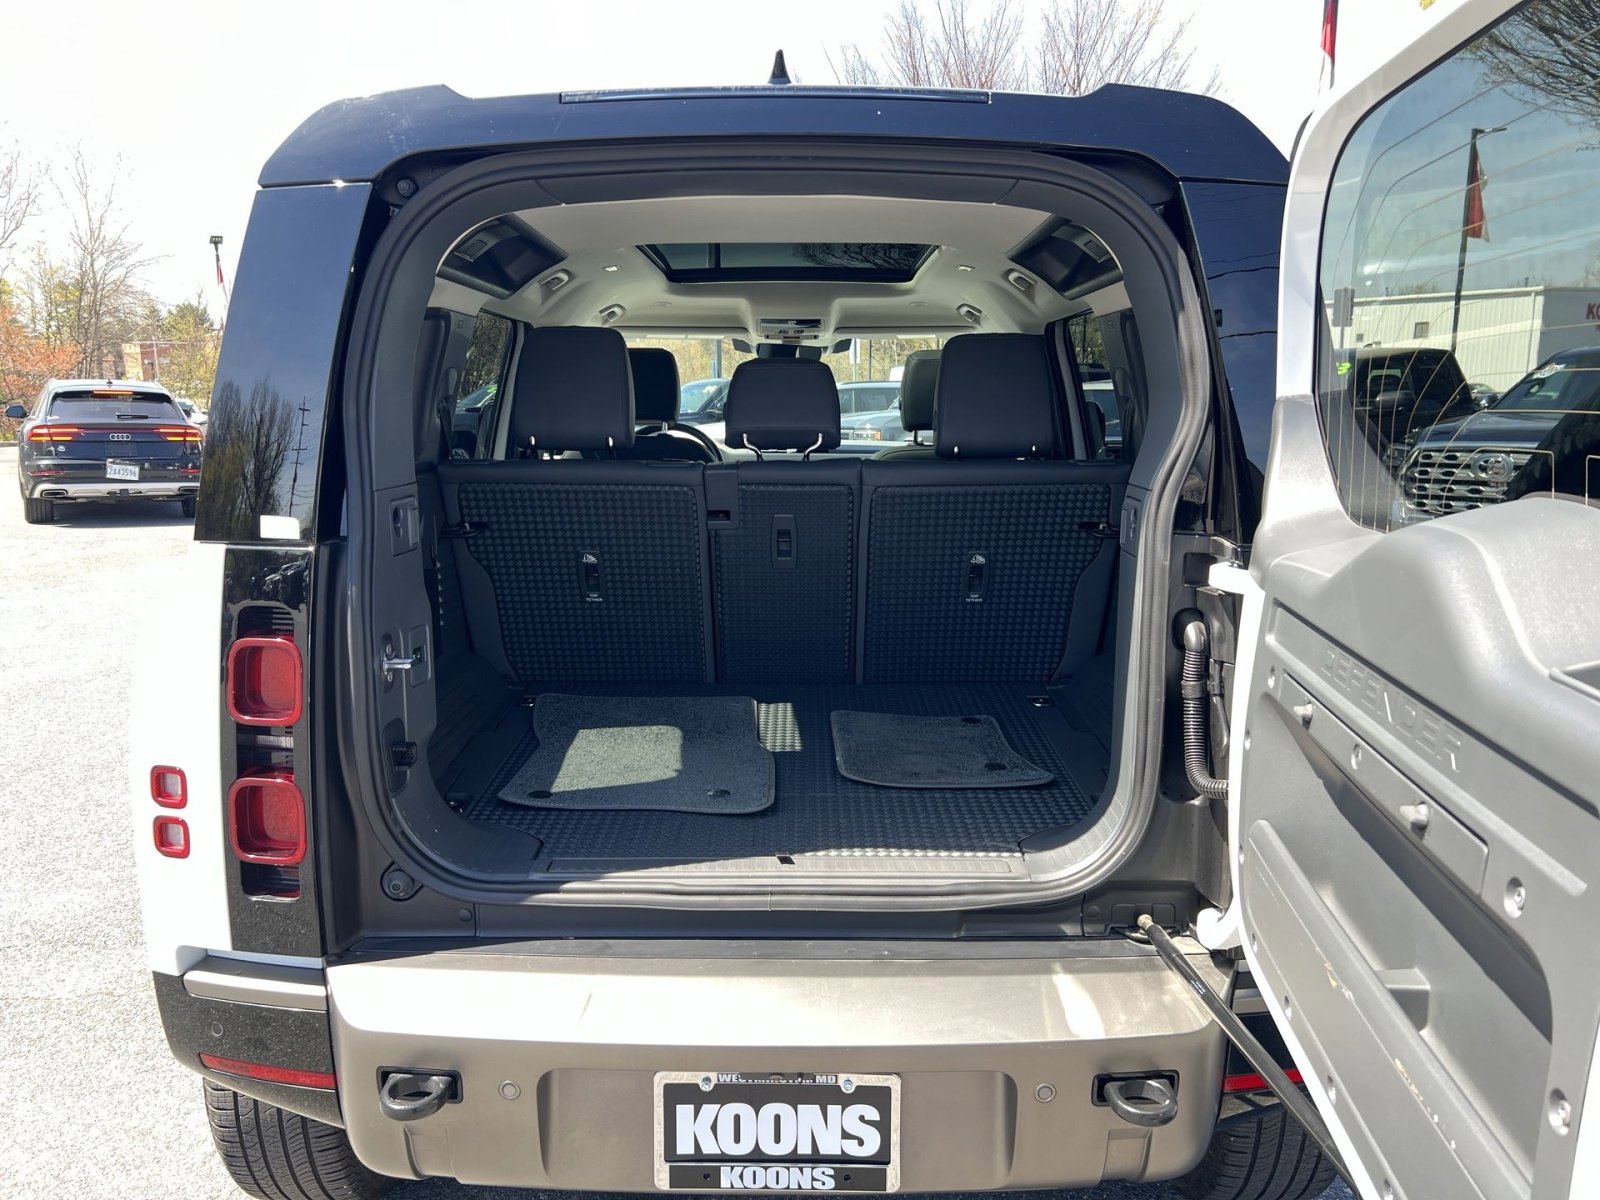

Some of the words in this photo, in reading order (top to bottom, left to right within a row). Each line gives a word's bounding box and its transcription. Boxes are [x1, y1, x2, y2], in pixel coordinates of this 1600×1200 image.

[1319, 643, 1465, 773] DEFENDER
[815, 1075, 837, 1084] MD
[675, 1102, 882, 1157] KOONS
[720, 1166, 836, 1190] KOONS
